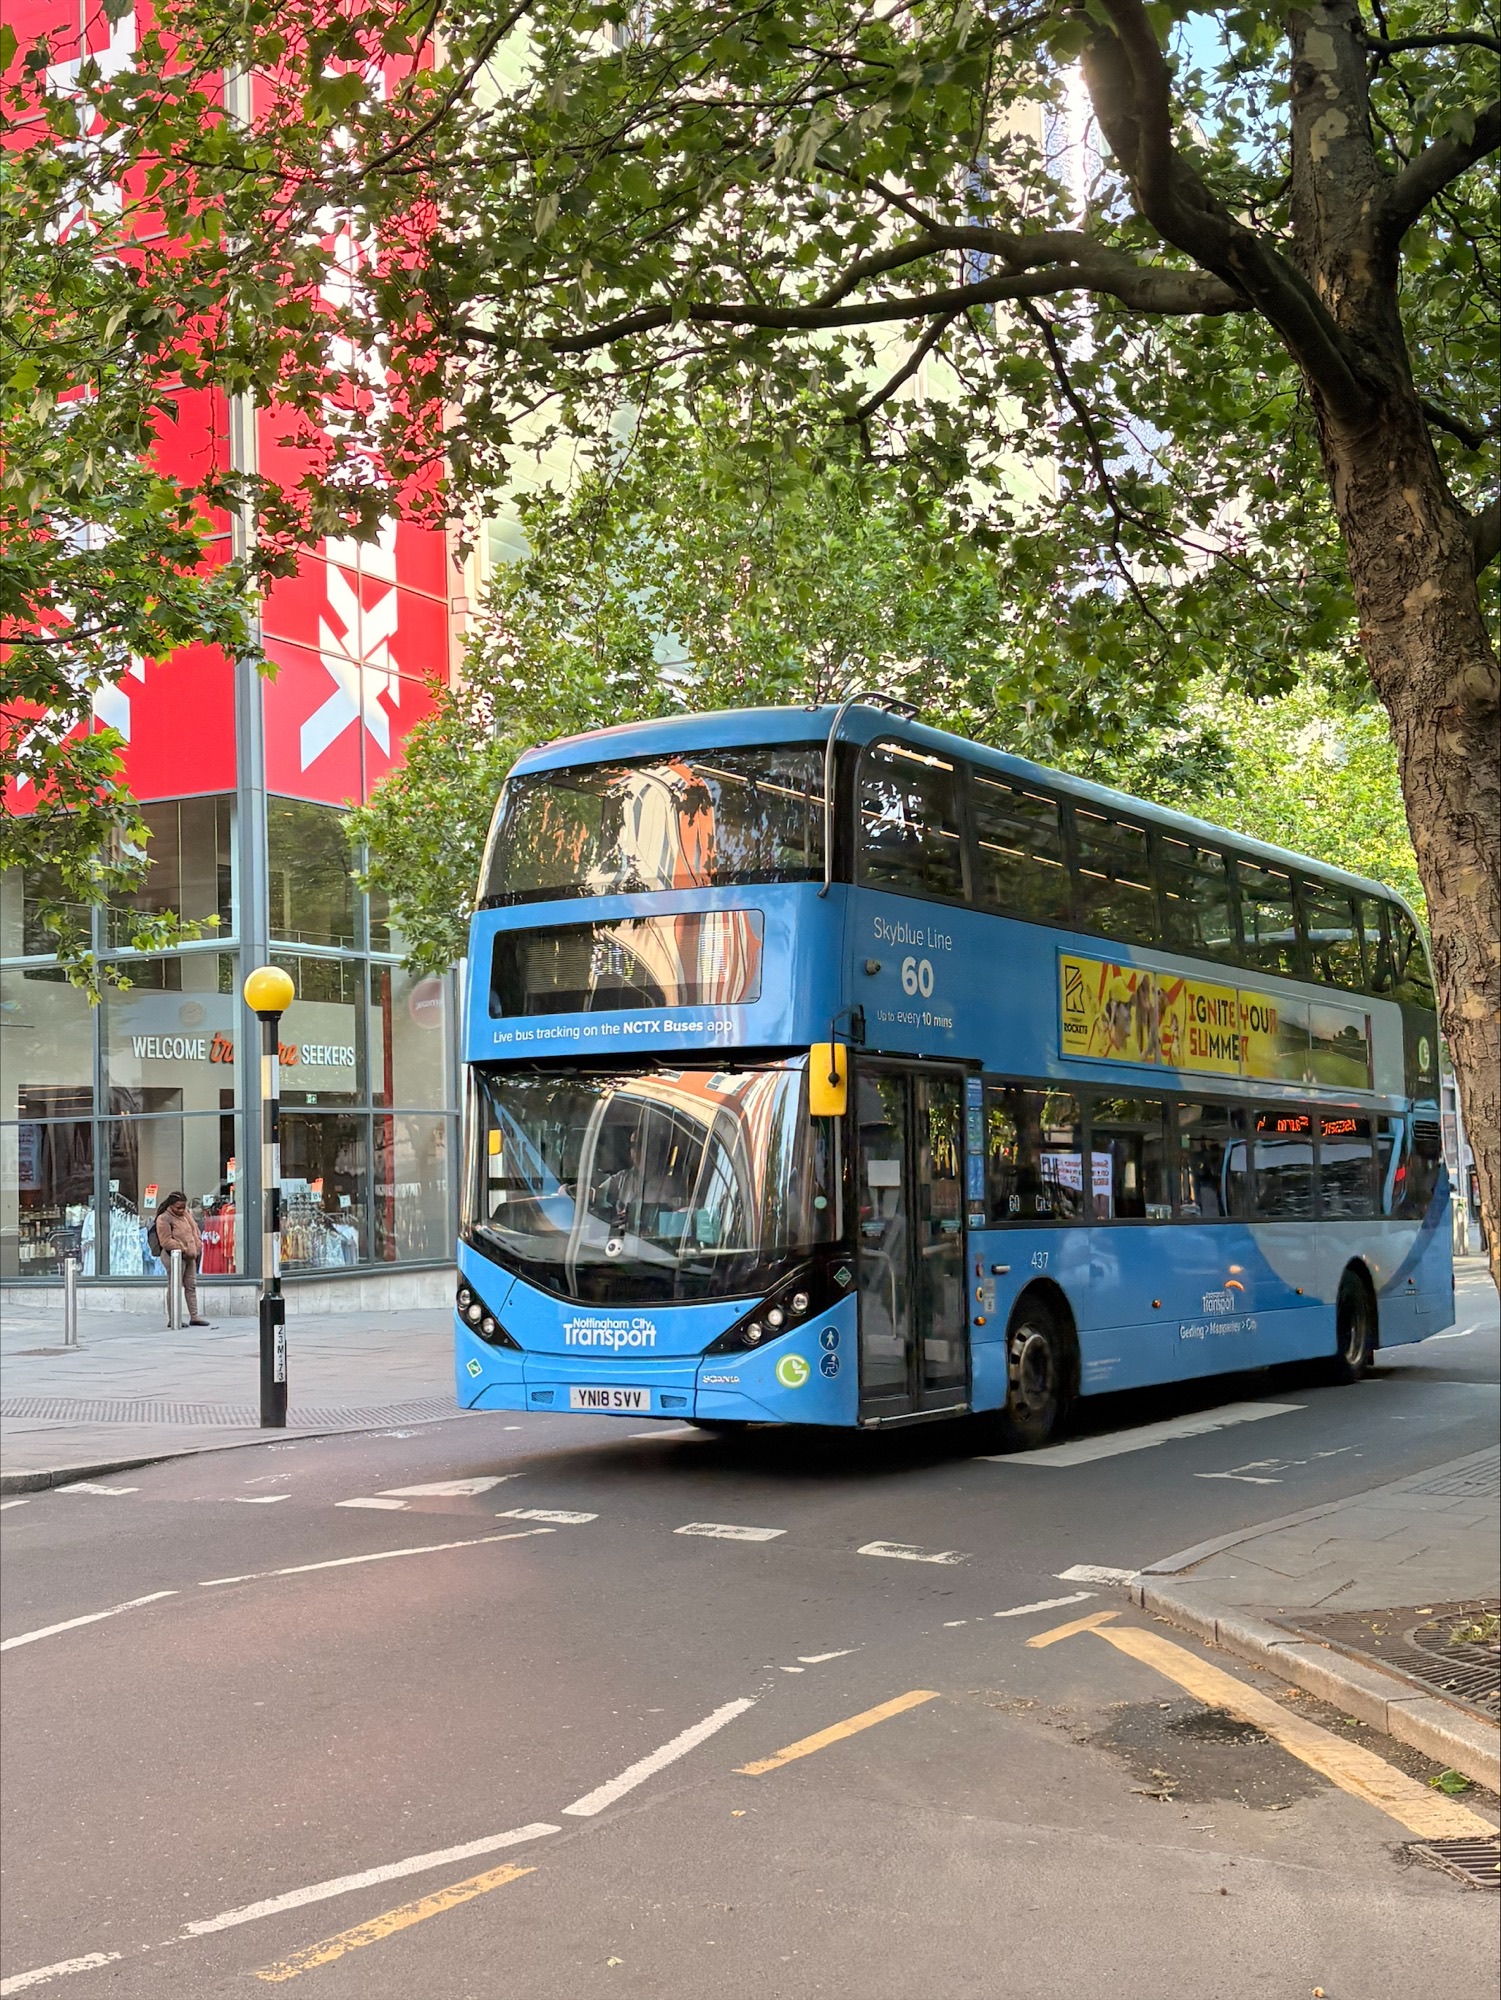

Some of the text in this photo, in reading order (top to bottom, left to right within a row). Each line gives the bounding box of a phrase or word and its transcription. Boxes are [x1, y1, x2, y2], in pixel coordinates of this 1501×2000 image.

[873, 917, 952, 951] Skyblue Line
[901, 956, 934, 998] 60
[897, 1011, 921, 1028] every
[922, 1011, 932, 1026] 10
[933, 1014, 953, 1028] mins
[1188, 994, 1277, 1035] IGNITE YOUR
[493, 1020, 733, 1043] Live bus tracking on the NCTX Buses app
[1190, 1027, 1249, 1062] SUMMER
[132, 1036, 206, 1060] WELCOME
[301, 1044, 355, 1066] SEEKERS
[1031, 1251, 1049, 1269] 437
[563, 1323, 657, 1351] Transport
[573, 1317, 652, 1331] Nottingham City
[578, 1389, 642, 1408] YN18 SVV
